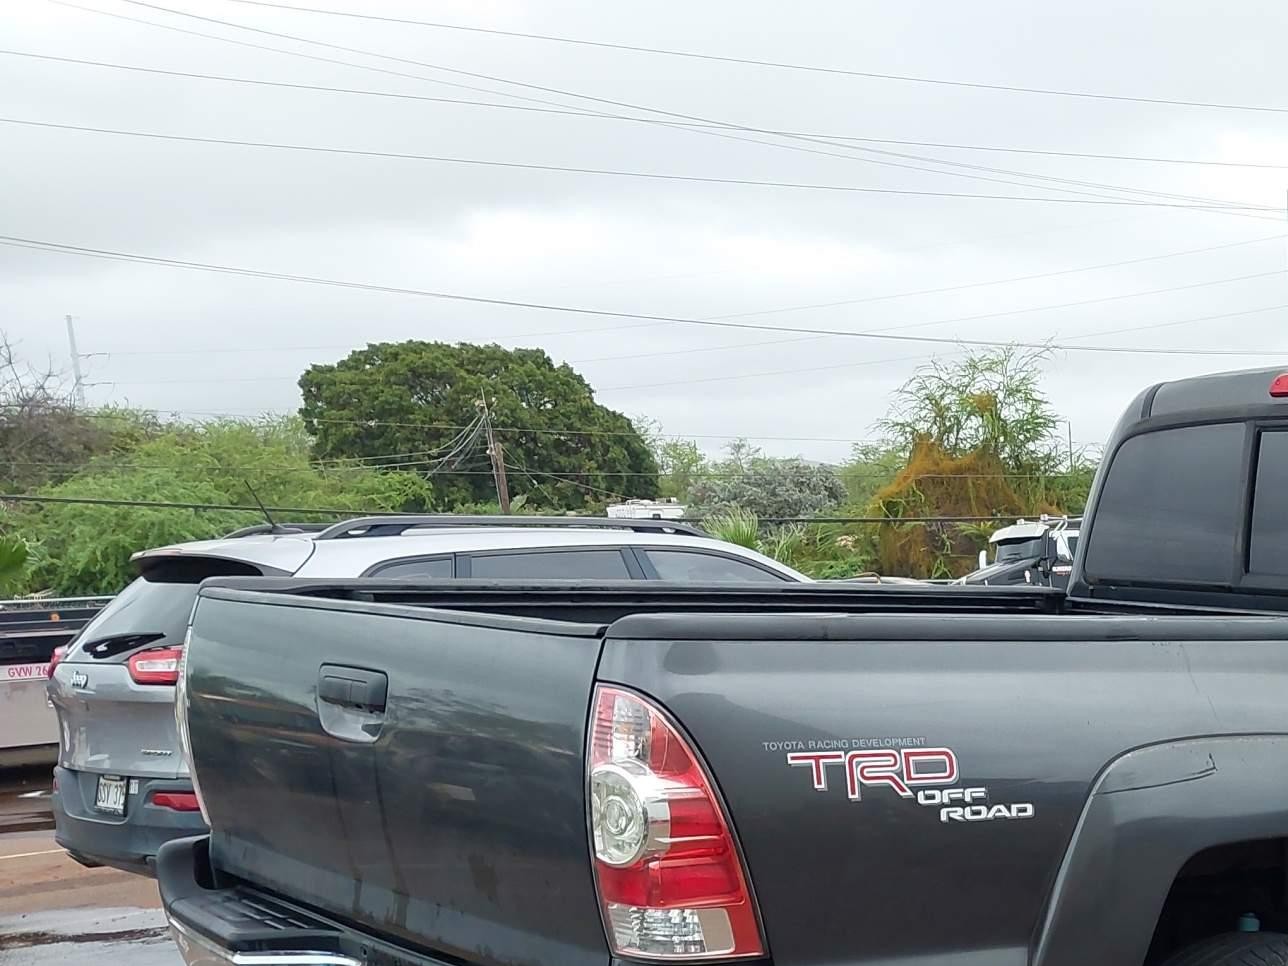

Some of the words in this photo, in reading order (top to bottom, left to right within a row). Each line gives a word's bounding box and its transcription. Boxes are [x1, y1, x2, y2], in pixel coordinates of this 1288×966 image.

[8, 666, 32, 677] GVW
[762, 742, 805, 751] TOYOTA
[808, 740, 849, 749] RACING
[852, 737, 926, 748] DEVELOPMENT
[787, 747, 959, 800] TRD
[917, 787, 987, 805] OFF
[940, 803, 1035, 822] ROAD
